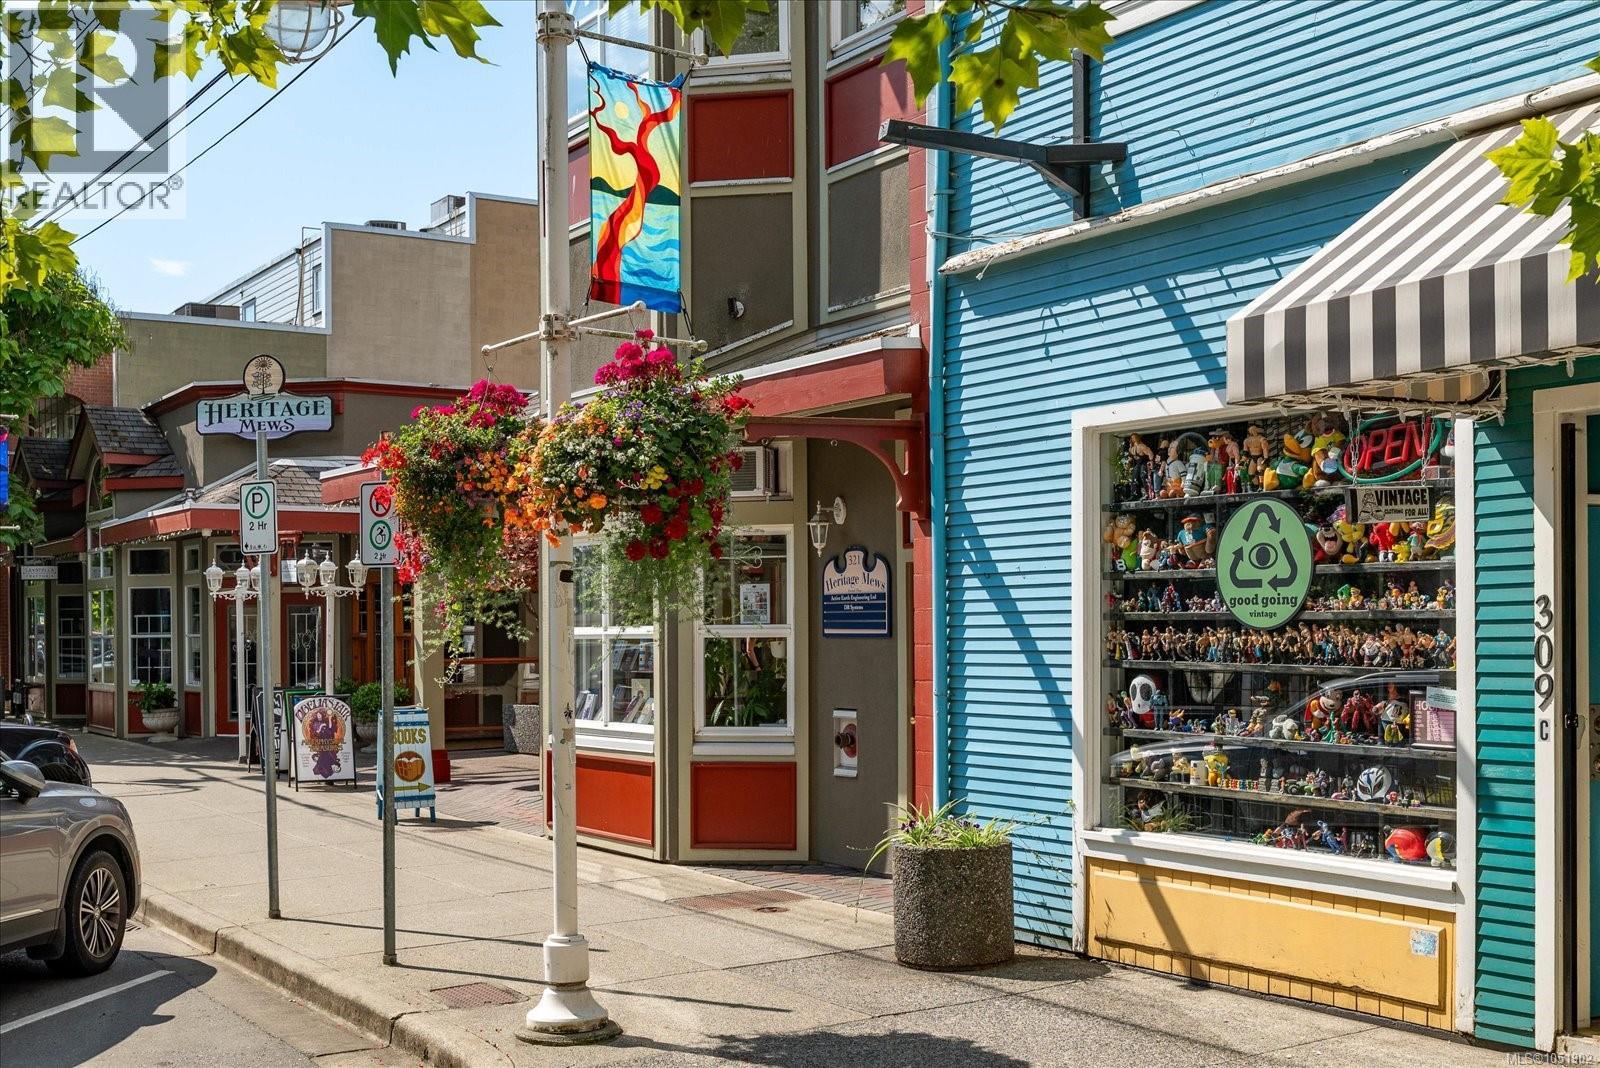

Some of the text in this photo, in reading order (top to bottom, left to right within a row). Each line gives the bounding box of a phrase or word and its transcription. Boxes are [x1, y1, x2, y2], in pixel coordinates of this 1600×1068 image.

[204, 400, 326, 427] HERITAGE
[239, 418, 295, 434] MEWS
[1344, 416, 1432, 473] OPEN
[252, 493, 263, 513] P
[1375, 489, 1428, 506] VINTAGE
[1405, 508, 1416, 517] FOR
[249, 521, 267, 531] 2 Hr
[374, 552, 379, 560] 2
[848, 554, 861, 566] 321
[825, 572, 886, 592] Heritage Mews
[1229, 592, 1298, 608] good going
[1249, 610, 1277, 619] vintage
[1534, 594, 1554, 713] 309
[1540, 720, 1549, 741] C
